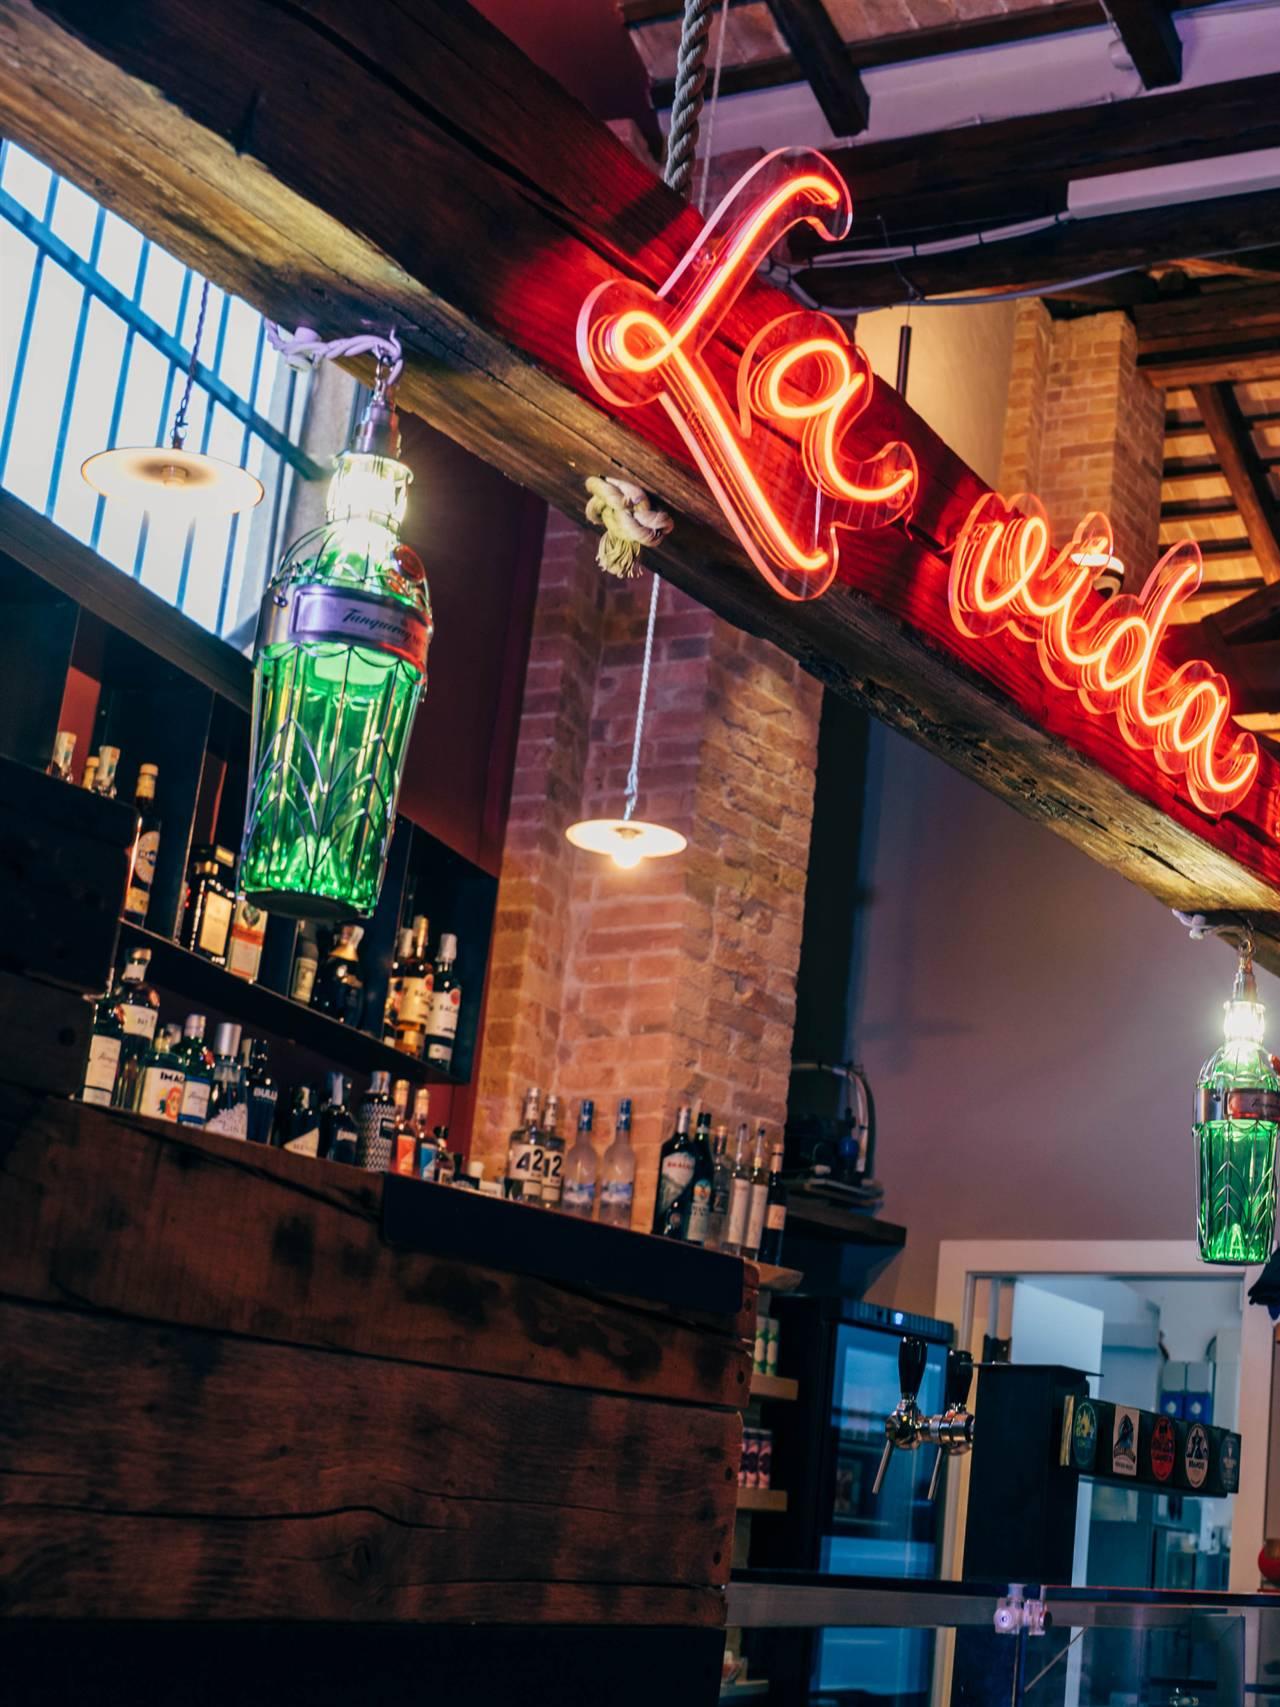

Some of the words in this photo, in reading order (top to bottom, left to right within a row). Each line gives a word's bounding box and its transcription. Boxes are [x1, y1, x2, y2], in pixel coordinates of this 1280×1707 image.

[580, 150, 917, 595] La
[950, 496, 1259, 812] vida
[516, 1149, 544, 1171] 42
